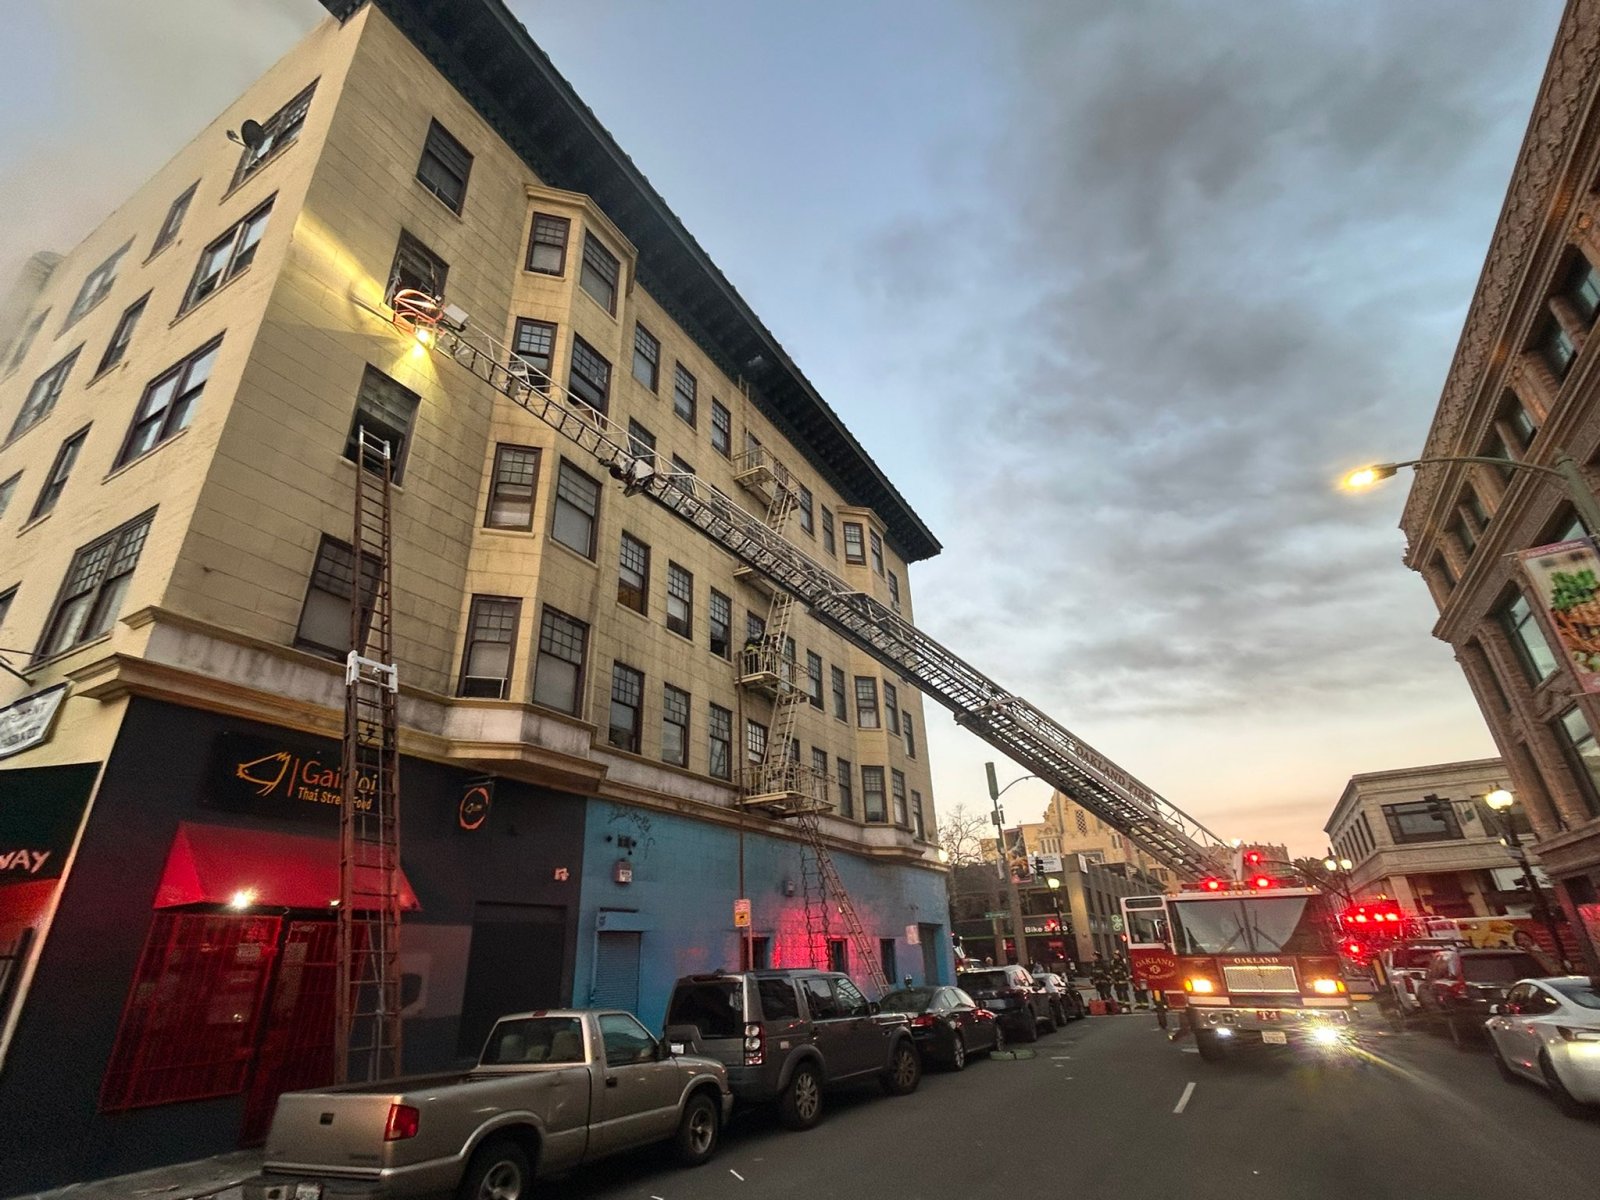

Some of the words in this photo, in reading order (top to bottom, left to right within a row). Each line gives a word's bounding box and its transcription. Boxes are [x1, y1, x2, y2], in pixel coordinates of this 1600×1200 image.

[1076, 746, 1125, 786] OAKLAND
[302, 760, 341, 788] Gai
[347, 768, 378, 795] oi
[298, 786, 318, 802] Thai
[321, 791, 345, 805] Stre
[1135, 957, 1175, 968] OAKLAND
[1233, 957, 1279, 965] OAKLAND
